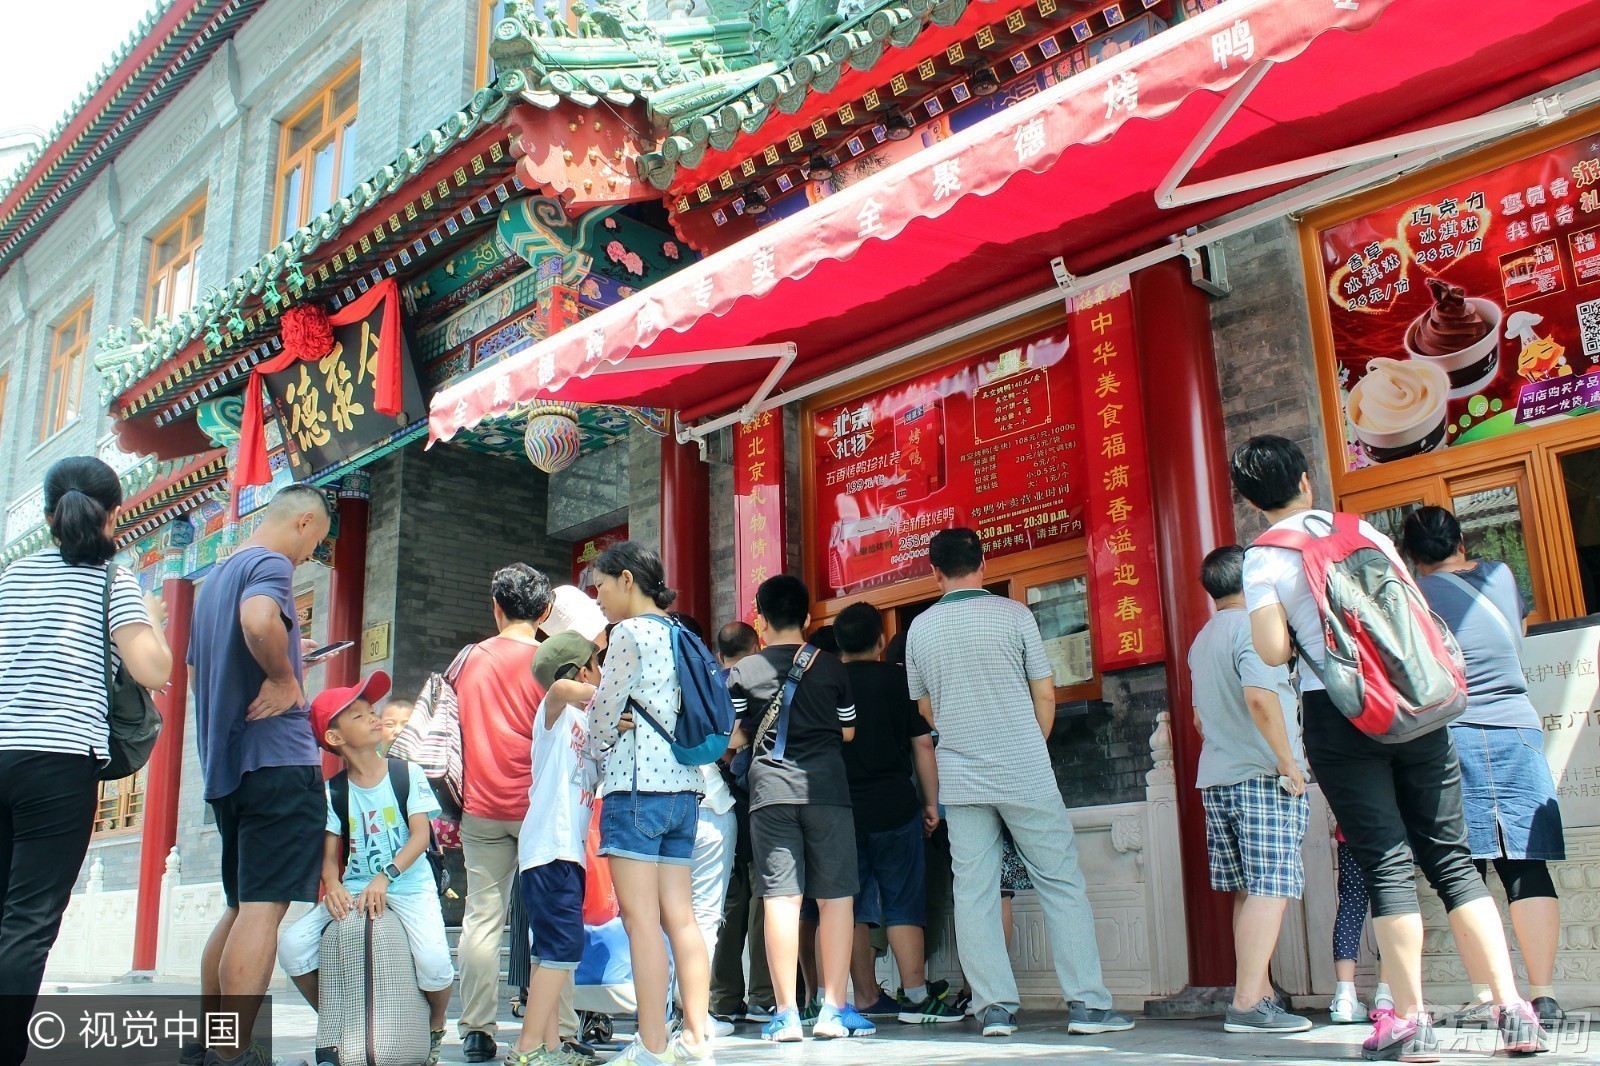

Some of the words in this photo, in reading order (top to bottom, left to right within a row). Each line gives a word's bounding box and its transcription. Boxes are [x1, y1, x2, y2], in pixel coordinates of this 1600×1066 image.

[857, 0, 1360, 238] 全聚德烤鸭
[1411, 191, 1485, 226] 巧克力
[1418, 217, 1479, 243] 冰淇淋
[1347, 242, 1382, 272] 香草
[1416, 237, 1483, 265] 28元/份
[1344, 254, 1401, 294] 冰淇淋
[1348, 278, 1410, 312] 28元/份
[1522, 375, 1600, 405] 网店购买产品
[833, 407, 872, 438] 北京
[836, 433, 867, 460] 礼物
[826, 451, 902, 487] 五香烤鸭珍礼装
[1091, 312, 1145, 655] 中华美食福满香溢迎春到
[971, 484, 1070, 518] 烤鸭外卖营业时间
[888, 507, 955, 538] 外卖新鲜烤鸭
[996, 523, 1015, 536] a.m.
[1023, 512, 1049, 529] 20:30
[1050, 509, 1070, 524] p.m.
[370, 641, 380, 657] 30
